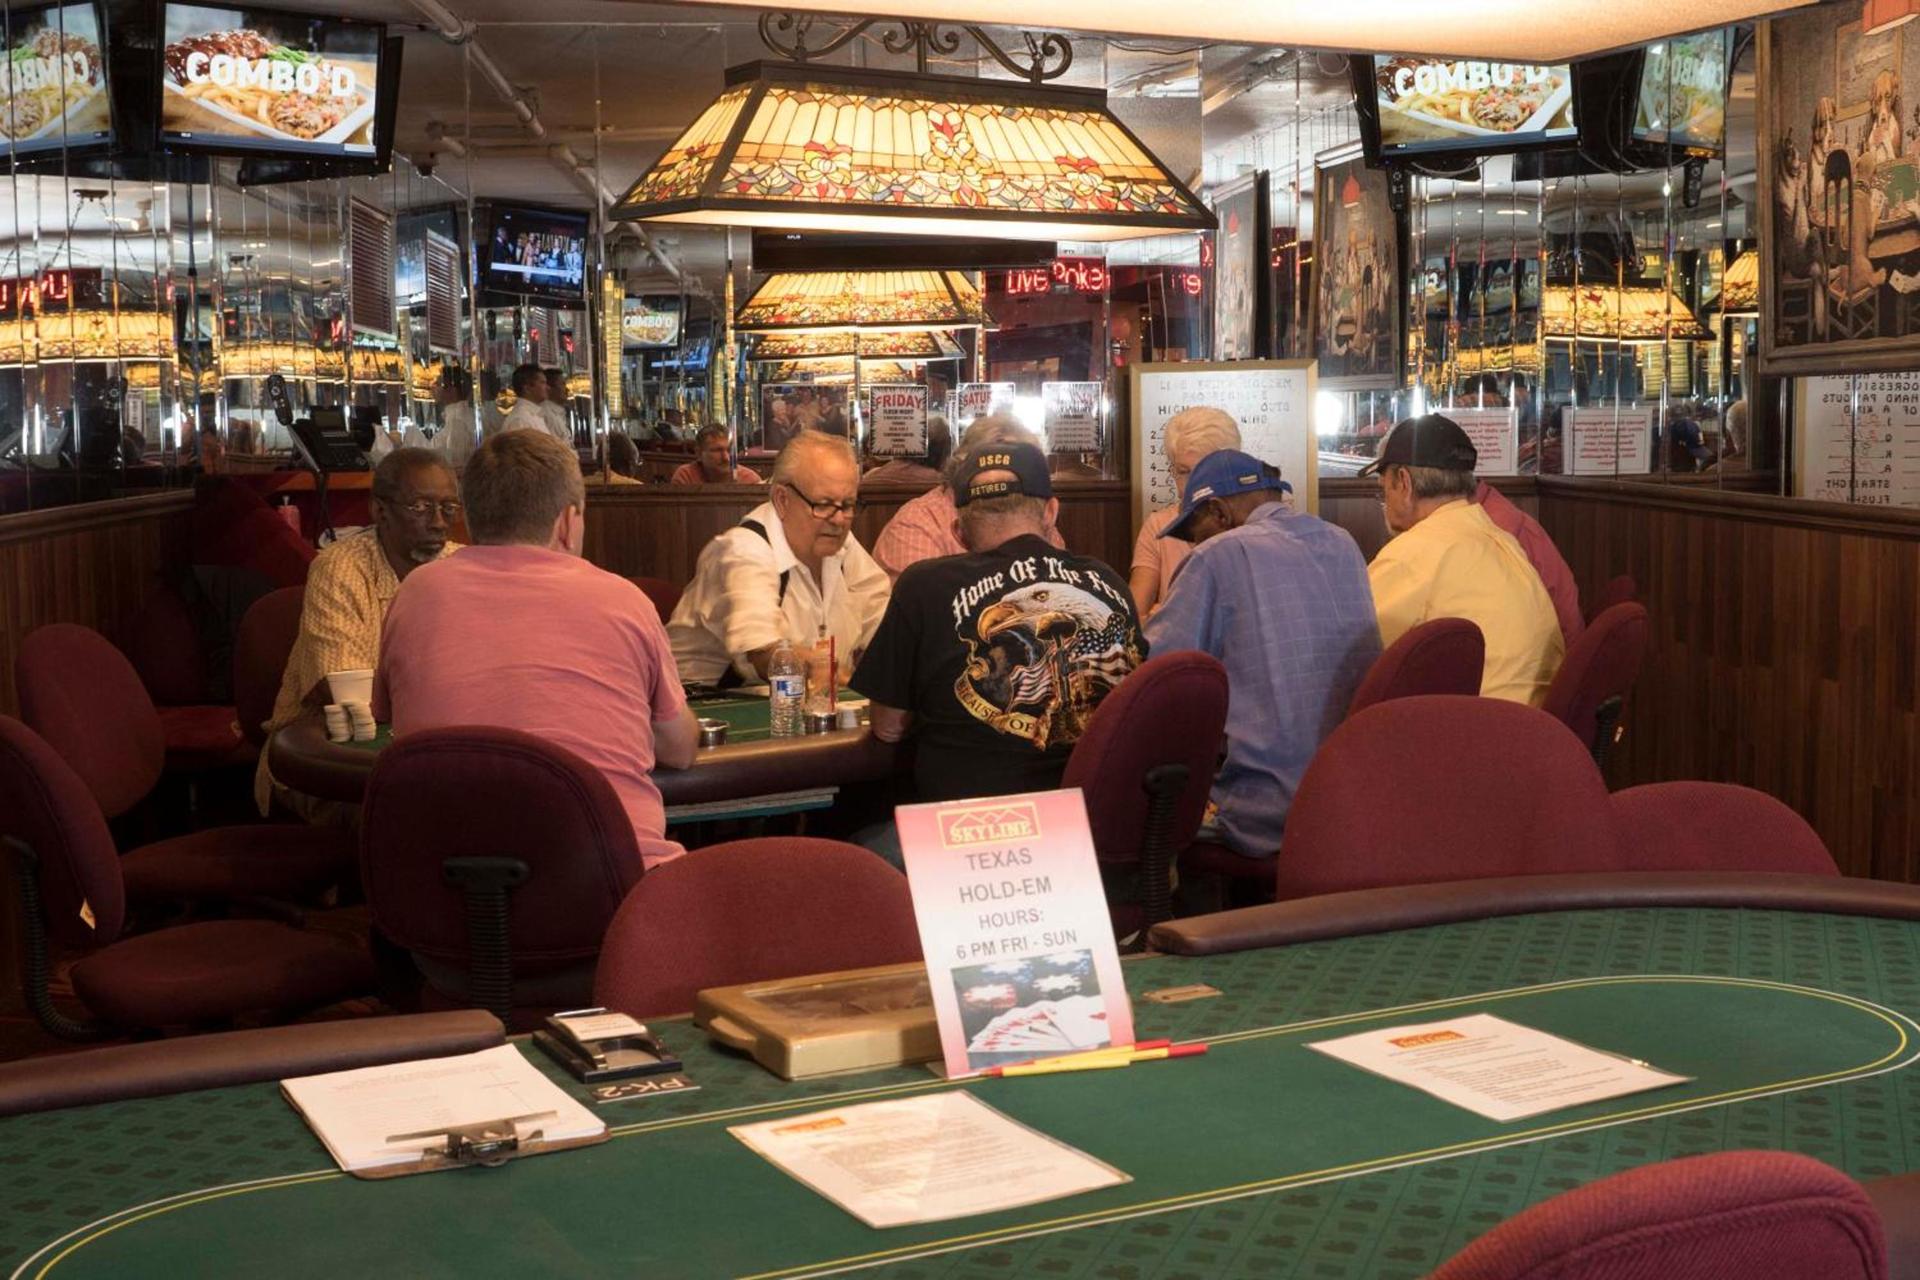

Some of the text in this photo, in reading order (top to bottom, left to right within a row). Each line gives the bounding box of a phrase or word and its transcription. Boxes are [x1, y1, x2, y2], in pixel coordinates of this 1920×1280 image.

[186, 51, 356, 97] COMBO'D
[1395, 61, 1549, 97] COMBOD
[875, 394, 922, 409] FRIDAY
[1150, 431, 1156, 440] 2
[1150, 446, 1156, 455] 3
[1150, 463, 1156, 472] 4
[970, 482, 1007, 497] RETIRED
[1150, 479, 1157, 487] 5
[1151, 494, 1157, 503] 6
[952, 572, 1005, 624] Home
[1043, 556, 1082, 584] The
[1009, 718, 1034, 733] OF
[950, 821, 1032, 844] SKYLINE
[966, 847, 1033, 871] TEXAS
[958, 876, 1052, 904] HOLD-EM
[979, 908, 1045, 930] HOURS:
[956, 944, 966, 960] 6
[971, 938, 997, 957] PM
[1001, 935, 1029, 954] FRI
[1044, 929, 1078, 949] SUN
[597, 1078, 686, 1098] PK-2
